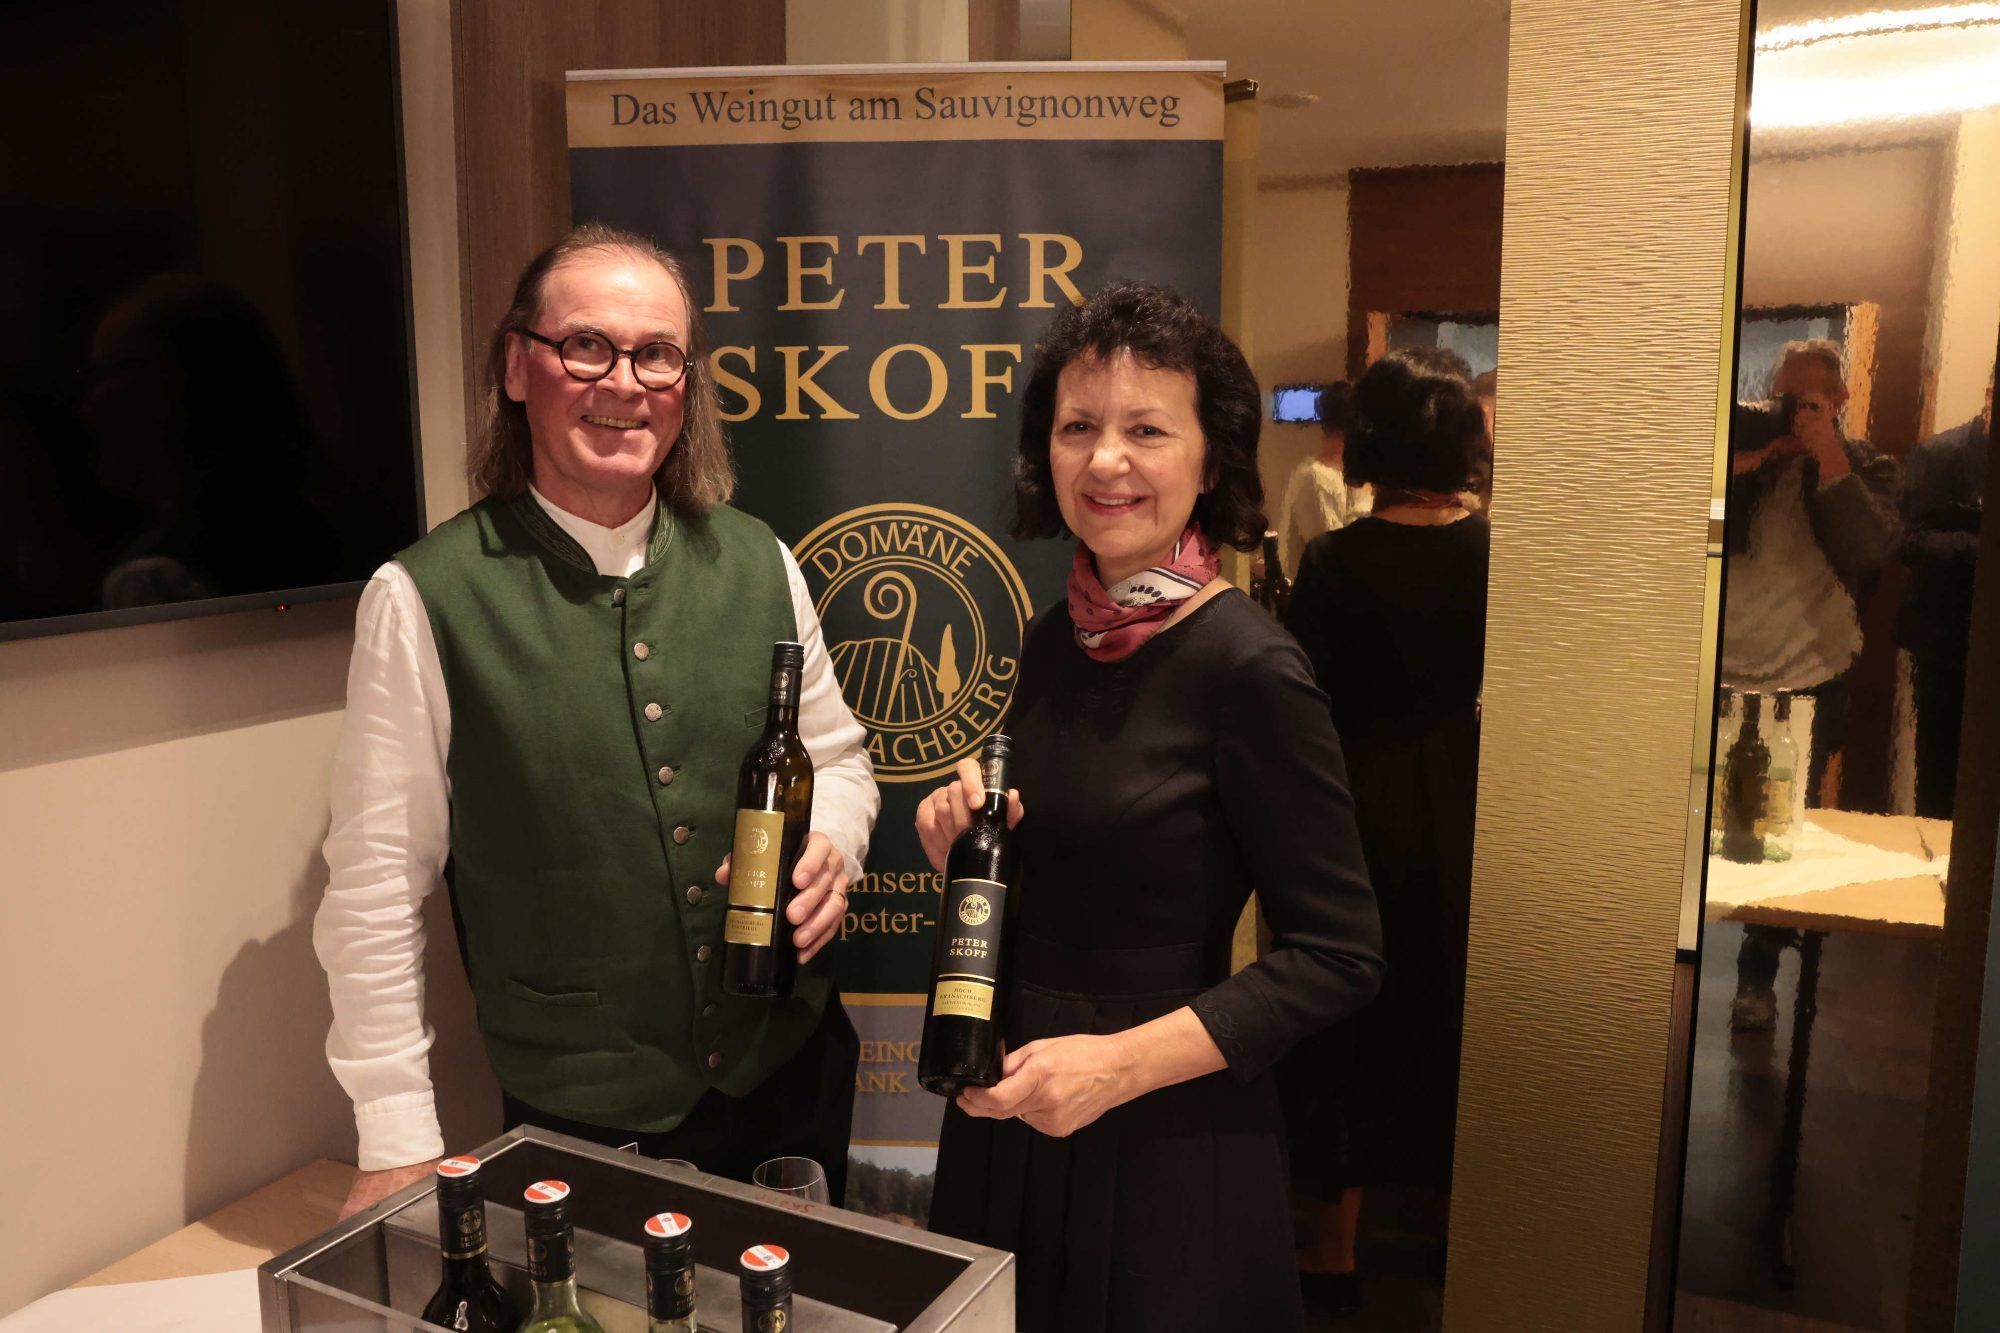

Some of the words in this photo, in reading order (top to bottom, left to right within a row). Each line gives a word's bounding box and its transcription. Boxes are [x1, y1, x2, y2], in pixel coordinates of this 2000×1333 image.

[610, 93, 677, 126] Das
[689, 89, 837, 130] Weingut
[848, 96, 903, 121] am
[915, 86, 1181, 128] Sauvignonweg
[701, 232, 1088, 313] PETER
[708, 343, 1046, 422] SKOF
[811, 521, 980, 581] DOMÄNE
[865, 653, 1018, 764] ACHBERG
[949, 948, 988, 959] SKOFF
[951, 938, 988, 949] PETER
